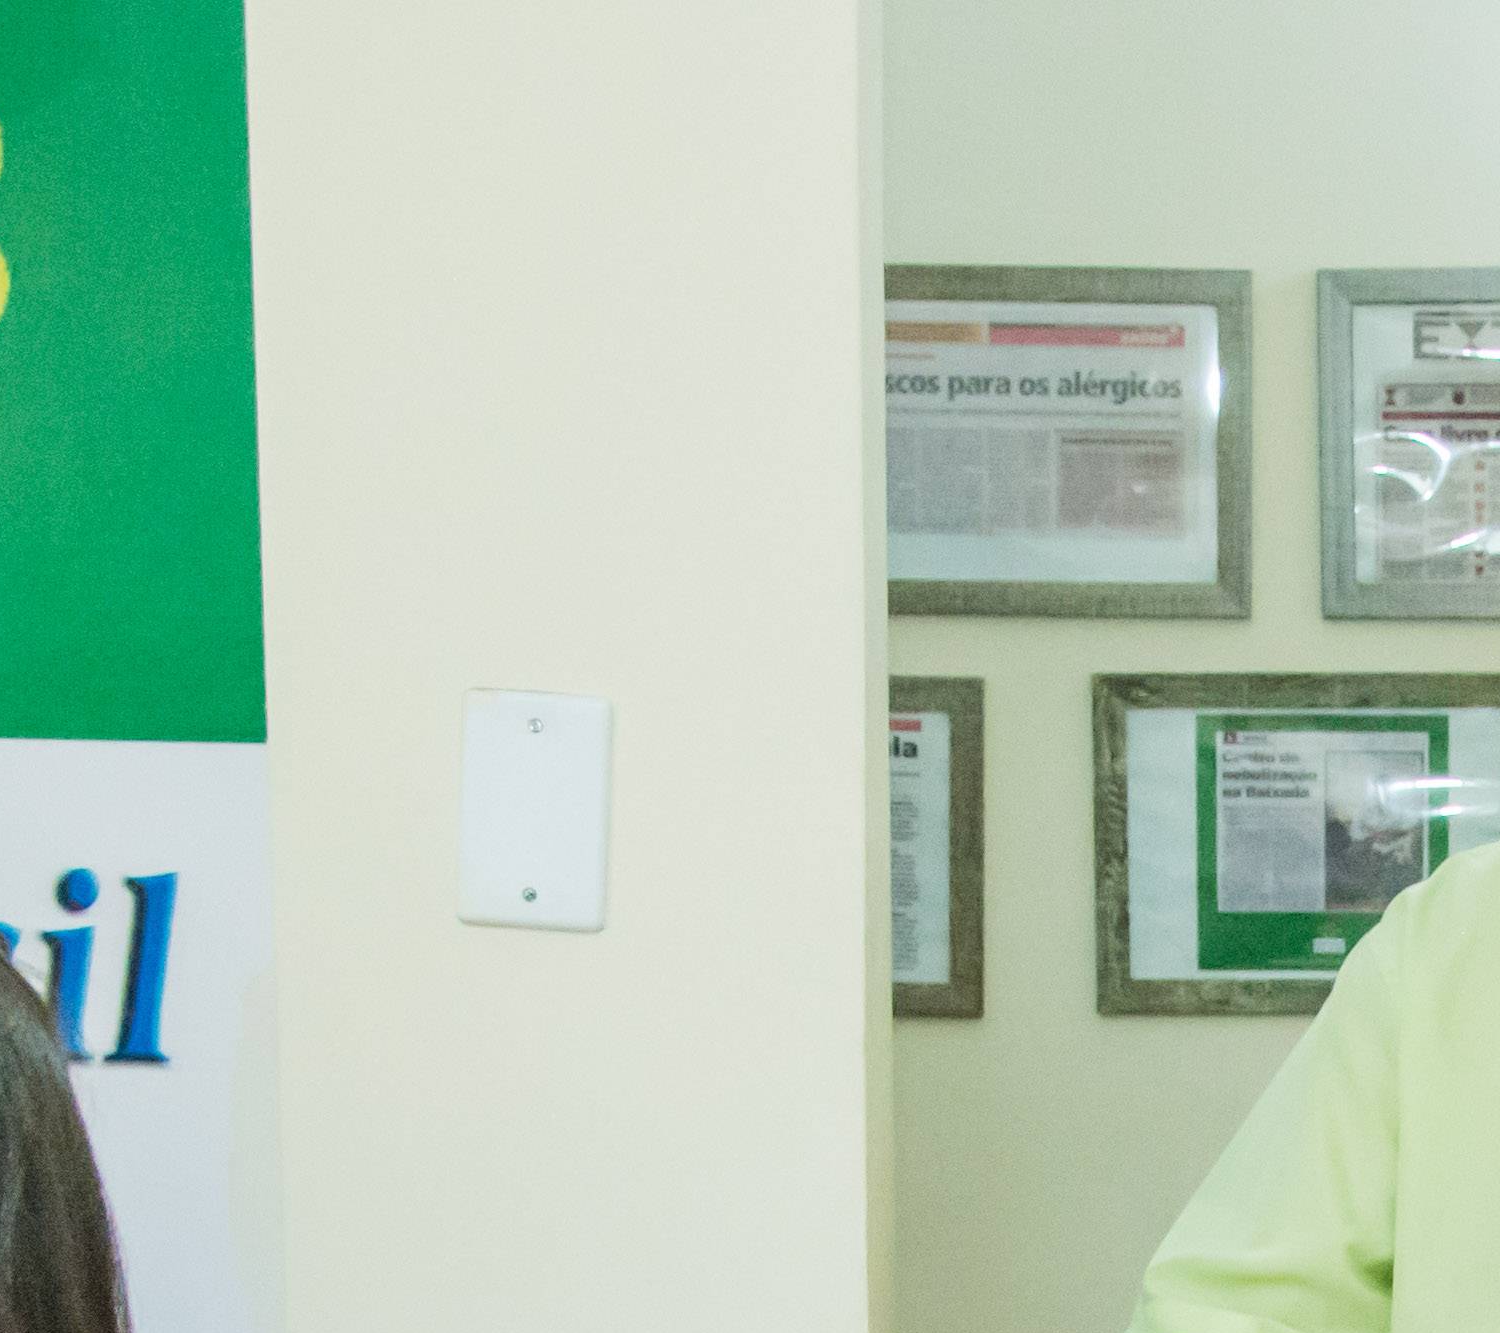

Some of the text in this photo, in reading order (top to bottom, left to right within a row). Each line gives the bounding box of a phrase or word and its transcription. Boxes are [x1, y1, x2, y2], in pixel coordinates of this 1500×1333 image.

[948, 375, 1011, 401] para
[1019, 375, 1048, 397] os
[1056, 370, 1182, 404] alérgicos
